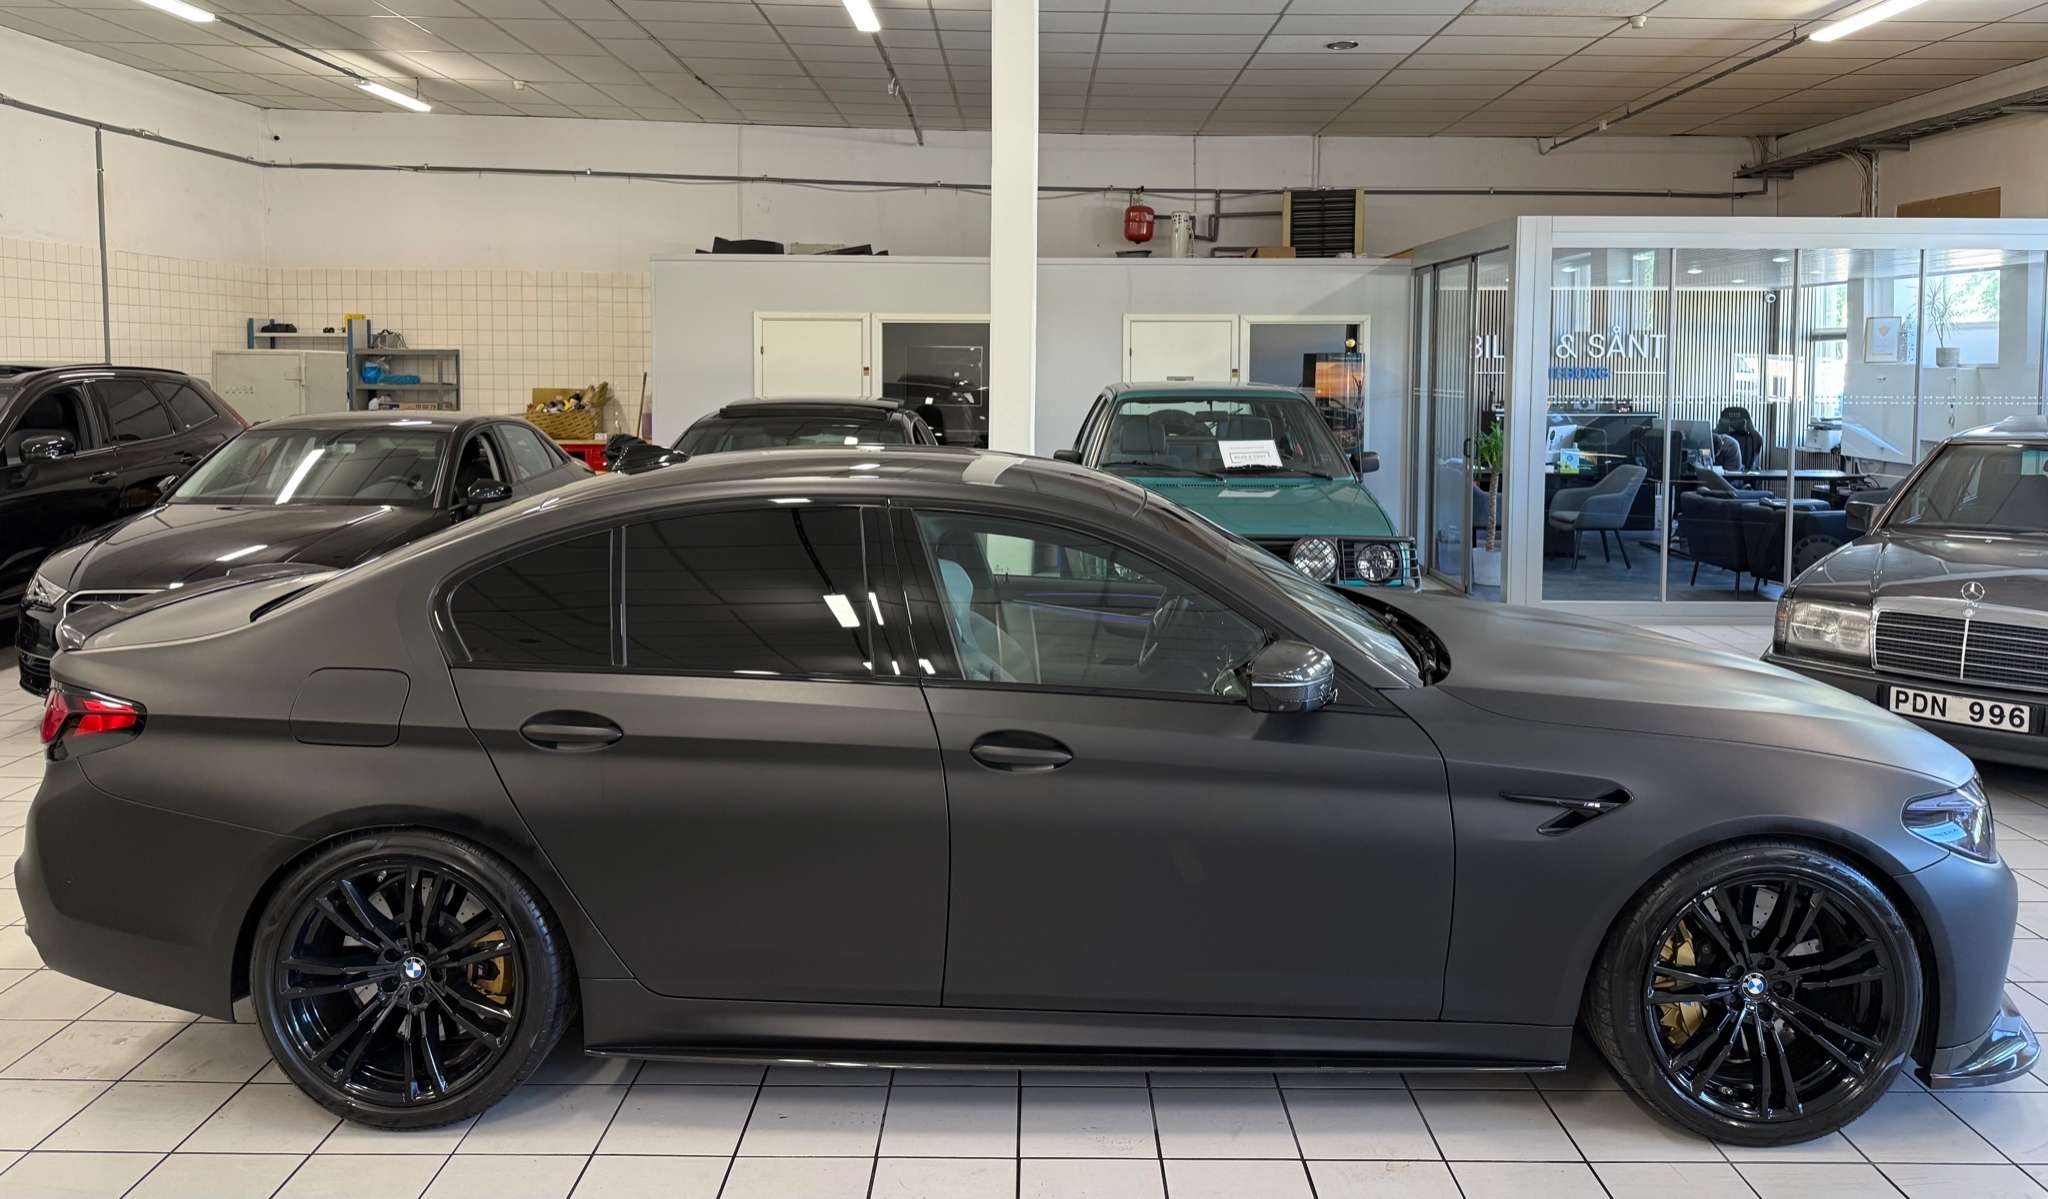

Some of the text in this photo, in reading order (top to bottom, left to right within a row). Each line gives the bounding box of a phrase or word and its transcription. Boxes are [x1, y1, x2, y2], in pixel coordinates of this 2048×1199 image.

[1556, 333, 1578, 358] &
[1588, 326, 1666, 358] SÅNT
[1895, 690, 2025, 728] PDN 996
